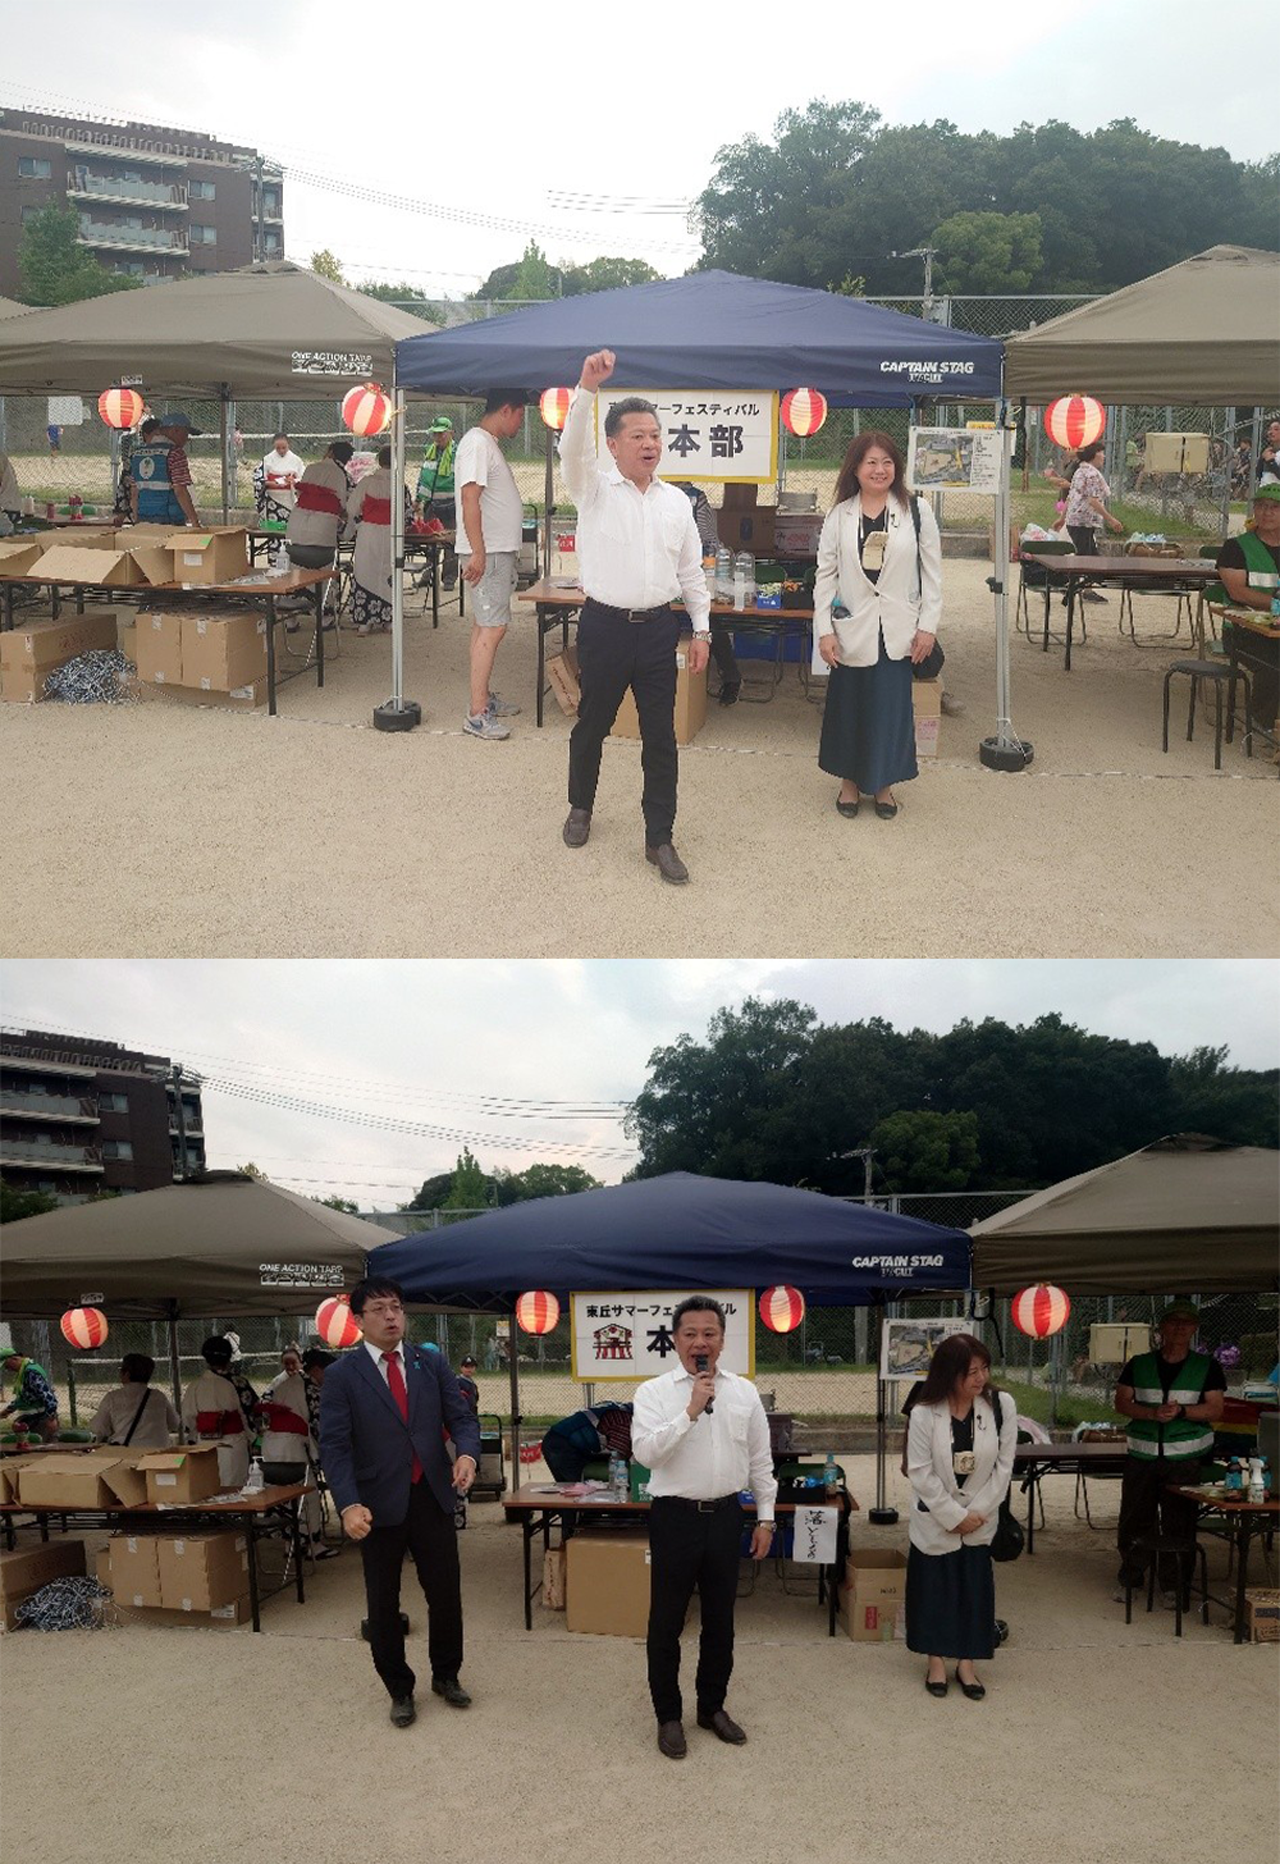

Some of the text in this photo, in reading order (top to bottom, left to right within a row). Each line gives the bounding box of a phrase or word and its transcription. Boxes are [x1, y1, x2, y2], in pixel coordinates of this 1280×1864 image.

[313, 352, 347, 361] ACTION
[880, 361, 975, 374] CAPTAIN STAG
[668, 424, 744, 458] 本部
[852, 1254, 944, 1268] CAPTAIN STAG
[259, 1263, 280, 1272] ONE
[281, 1264, 317, 1273] ACTION
[646, 1325, 676, 1358] 本
